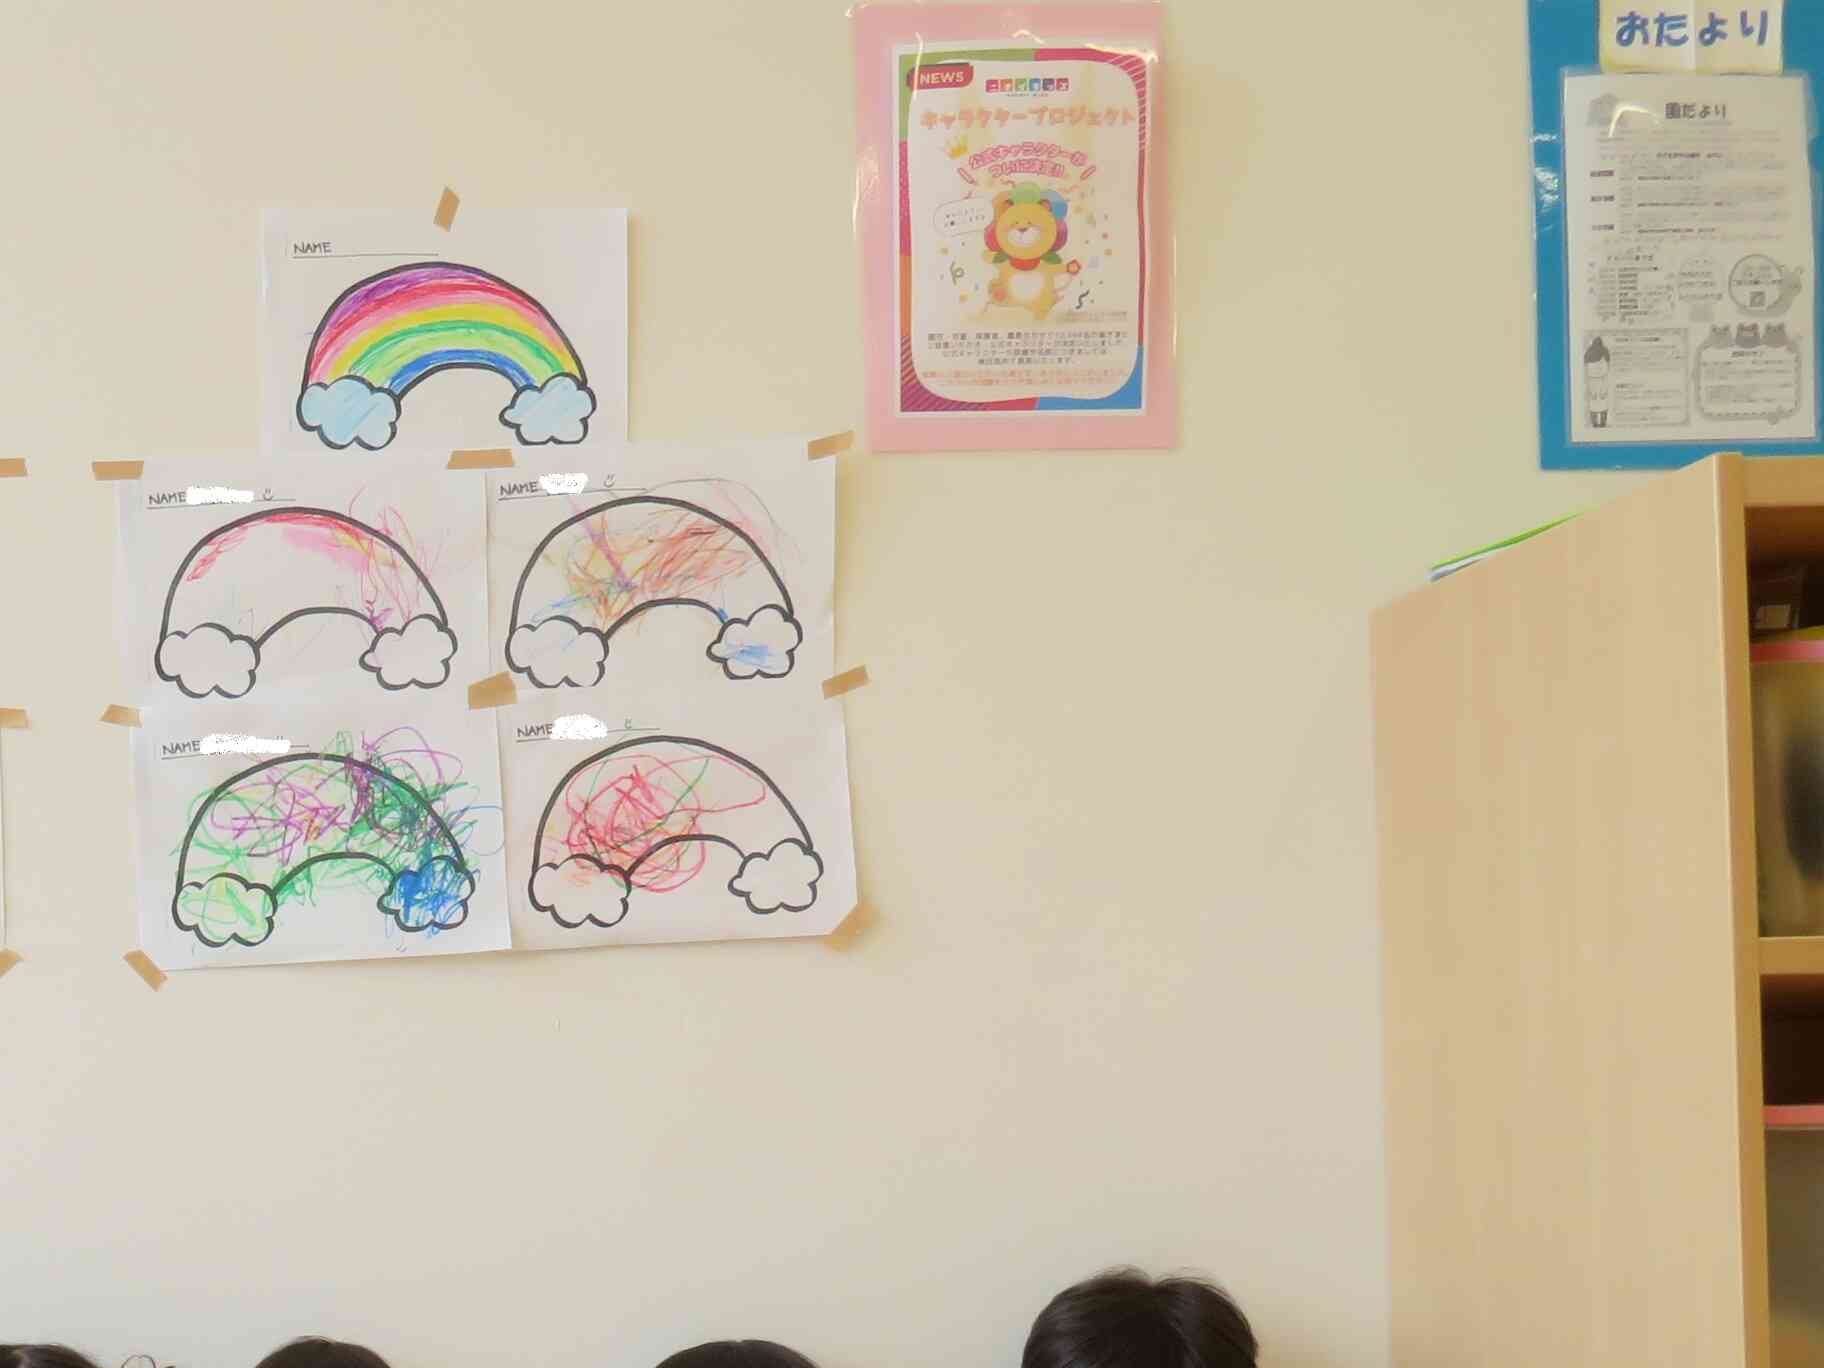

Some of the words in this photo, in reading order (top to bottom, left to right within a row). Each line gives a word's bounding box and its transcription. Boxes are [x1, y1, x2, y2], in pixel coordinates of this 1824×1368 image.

[1615, 9, 1769, 47] おだより
[919, 70, 965, 85] NEWS
[919, 105, 1136, 129] キャラクタープロジェクト
[293, 241, 332, 254] NAME
[499, 481, 539, 497] NAME
[148, 491, 187, 505] NAME
[516, 723, 553, 738] NAME
[161, 740, 201, 756] NAME
